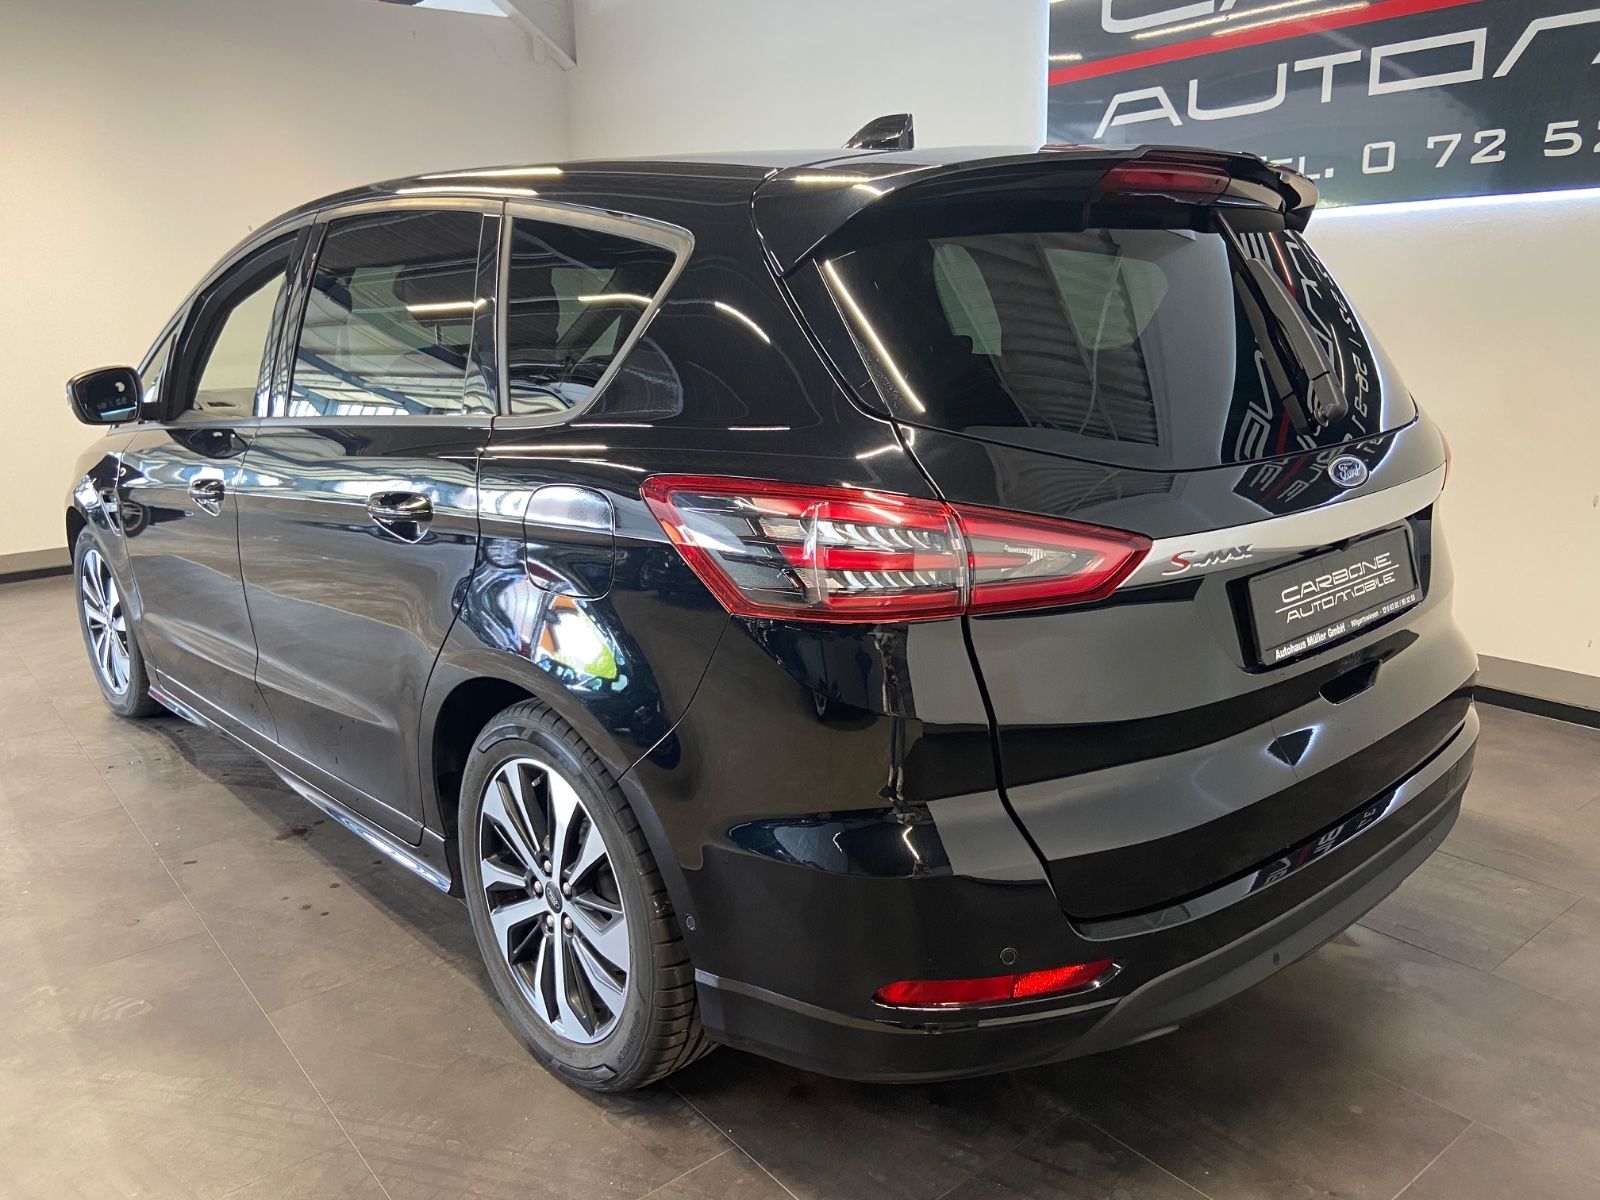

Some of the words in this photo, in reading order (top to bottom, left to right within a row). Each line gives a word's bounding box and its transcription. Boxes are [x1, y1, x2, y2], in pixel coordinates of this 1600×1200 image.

[1426, 129, 1507, 168] 72
[1543, 119, 1600, 157] 5
[1281, 552, 1392, 603] CARBONE
[1286, 571, 1396, 624] AUTOMOBILE
[1275, 641, 1307, 660] Autohaus
[1306, 632, 1327, 647] Müller
[1327, 622, 1346, 638] GmbH
